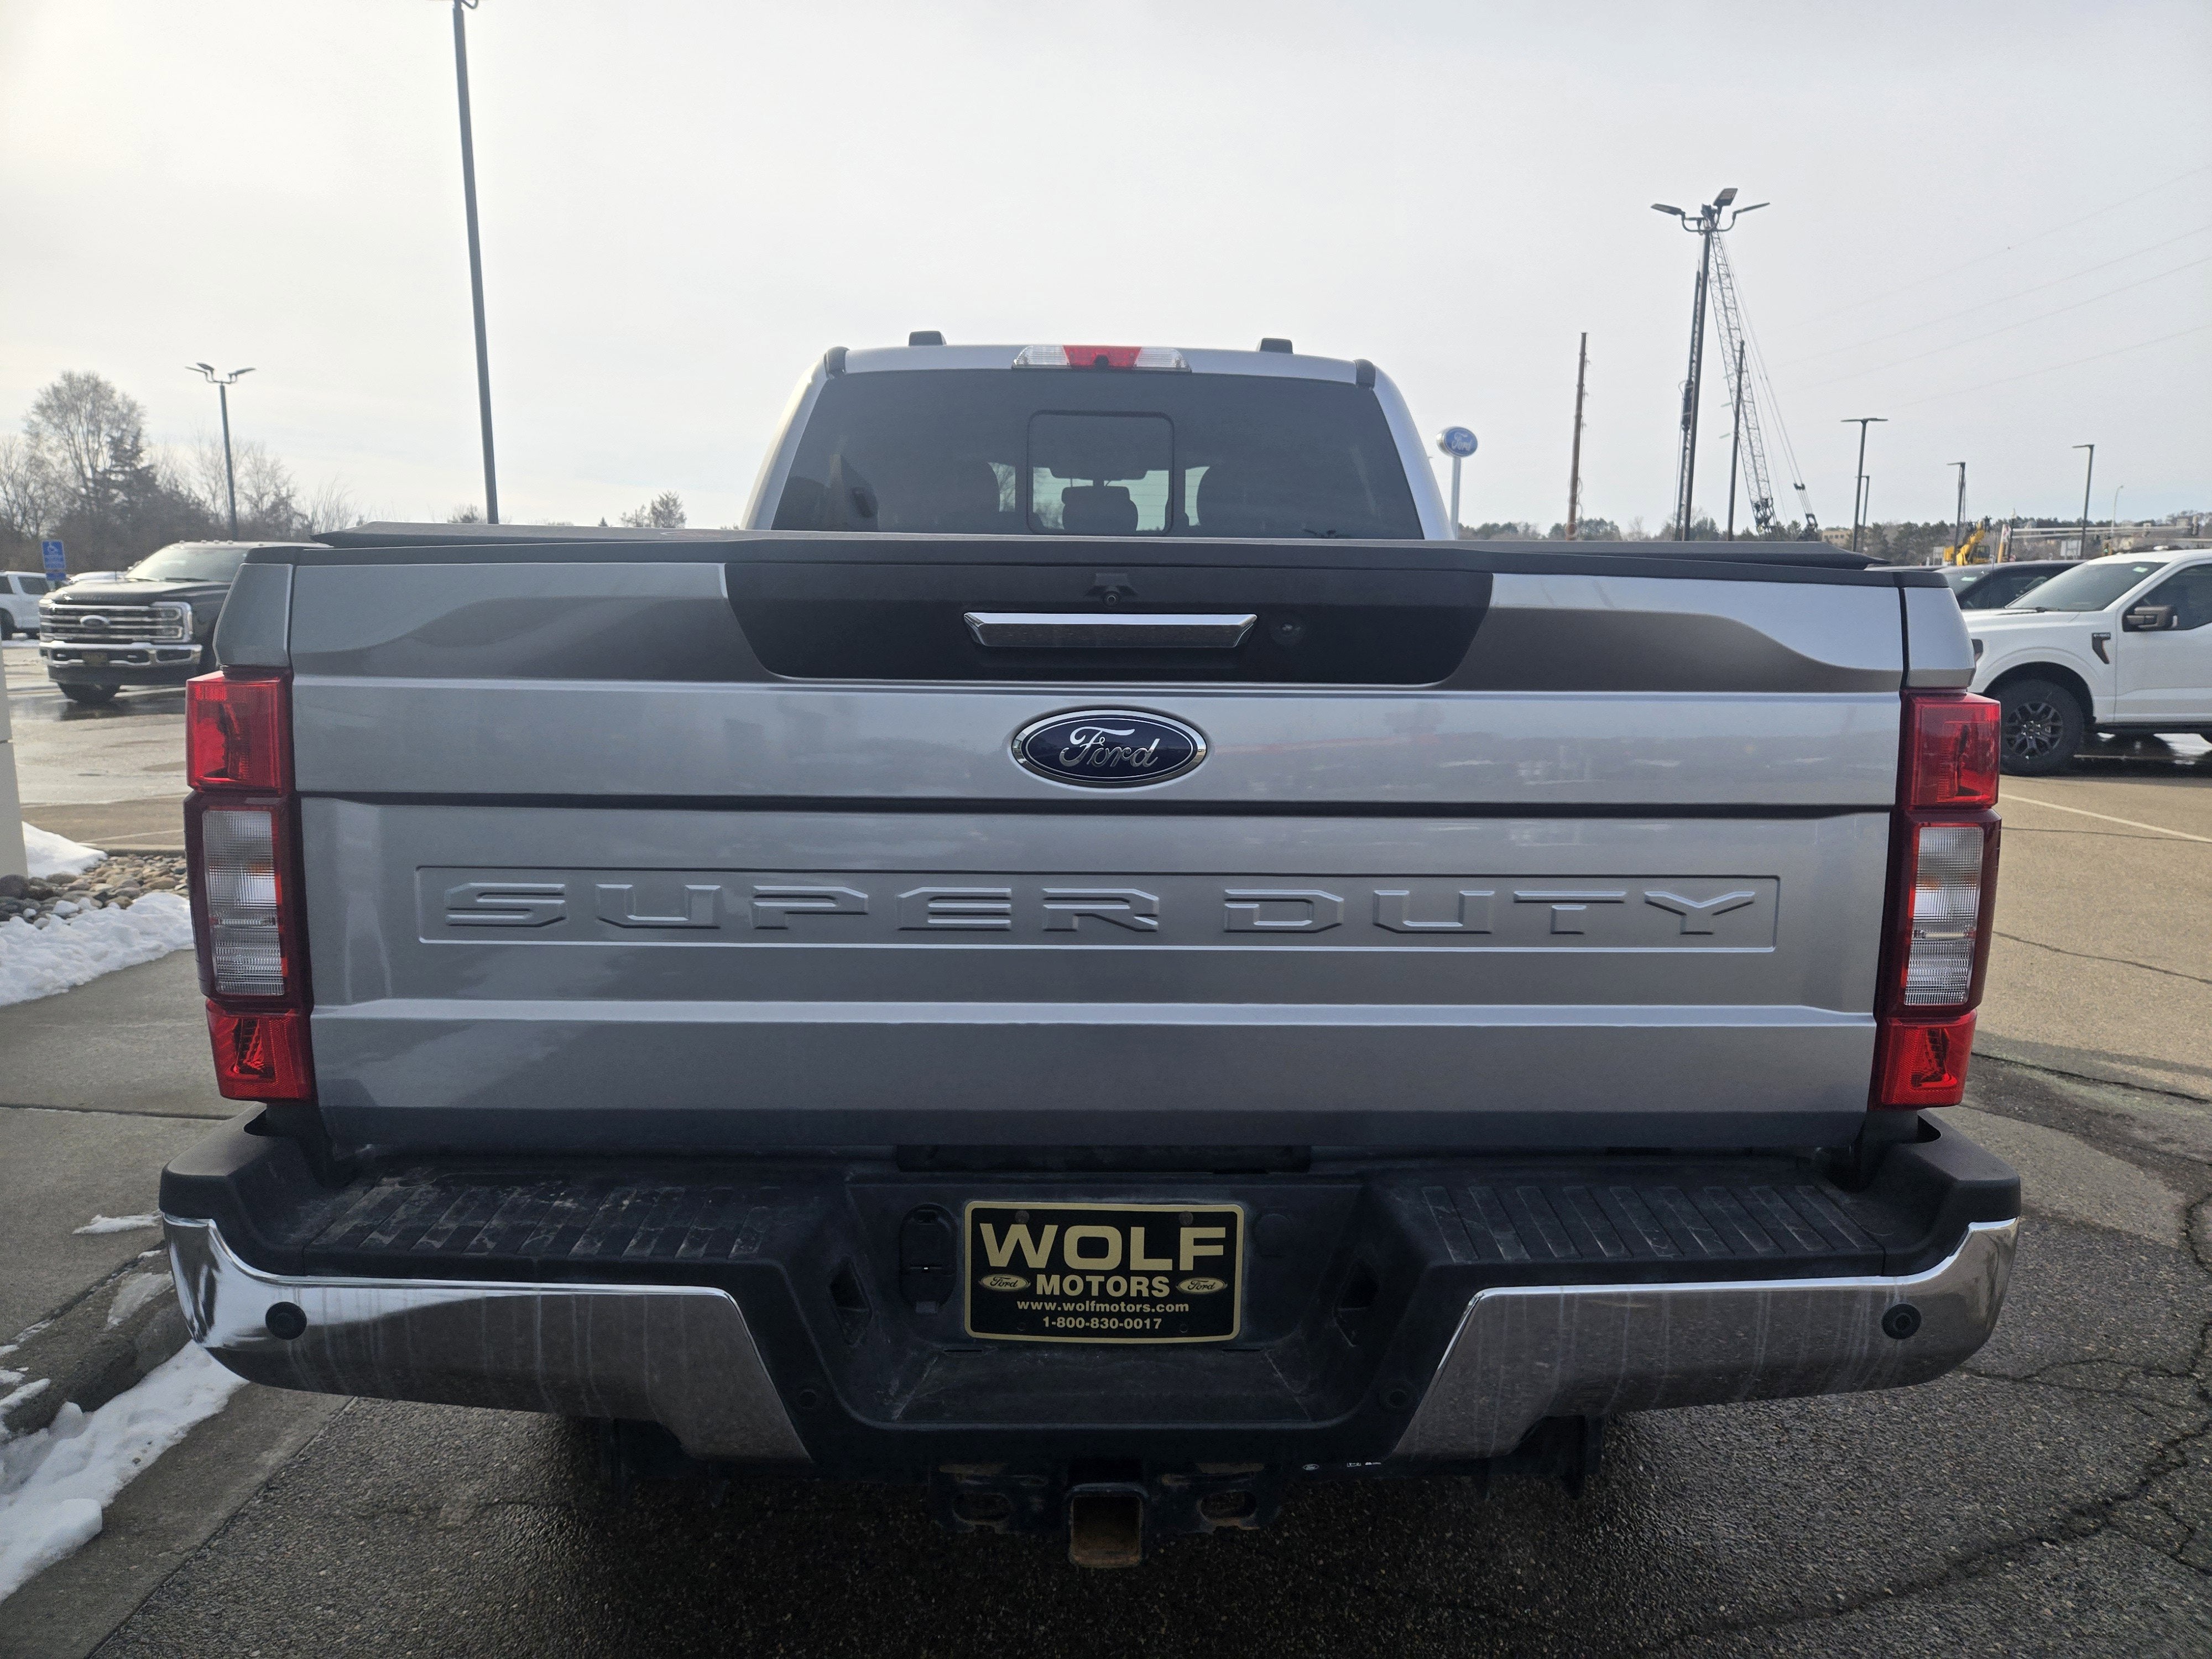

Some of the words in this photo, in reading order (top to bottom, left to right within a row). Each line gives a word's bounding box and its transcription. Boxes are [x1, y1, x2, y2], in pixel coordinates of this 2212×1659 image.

[1451, 432, 1473, 451] Ford
[1059, 726, 1160, 768] Ford
[444, 882, 1160, 932] SUPER
[1223, 889, 1756, 935] DUTY
[979, 1223, 1226, 1271] WOLF
[989, 1276, 1019, 1288] Ford
[1036, 1274, 1170, 1297] MOTORS
[1187, 1279, 1217, 1291] Ford
[1016, 1300, 1189, 1313] www.wolfmotors.com
[1043, 1316, 1162, 1329] 1-800-830-0017
